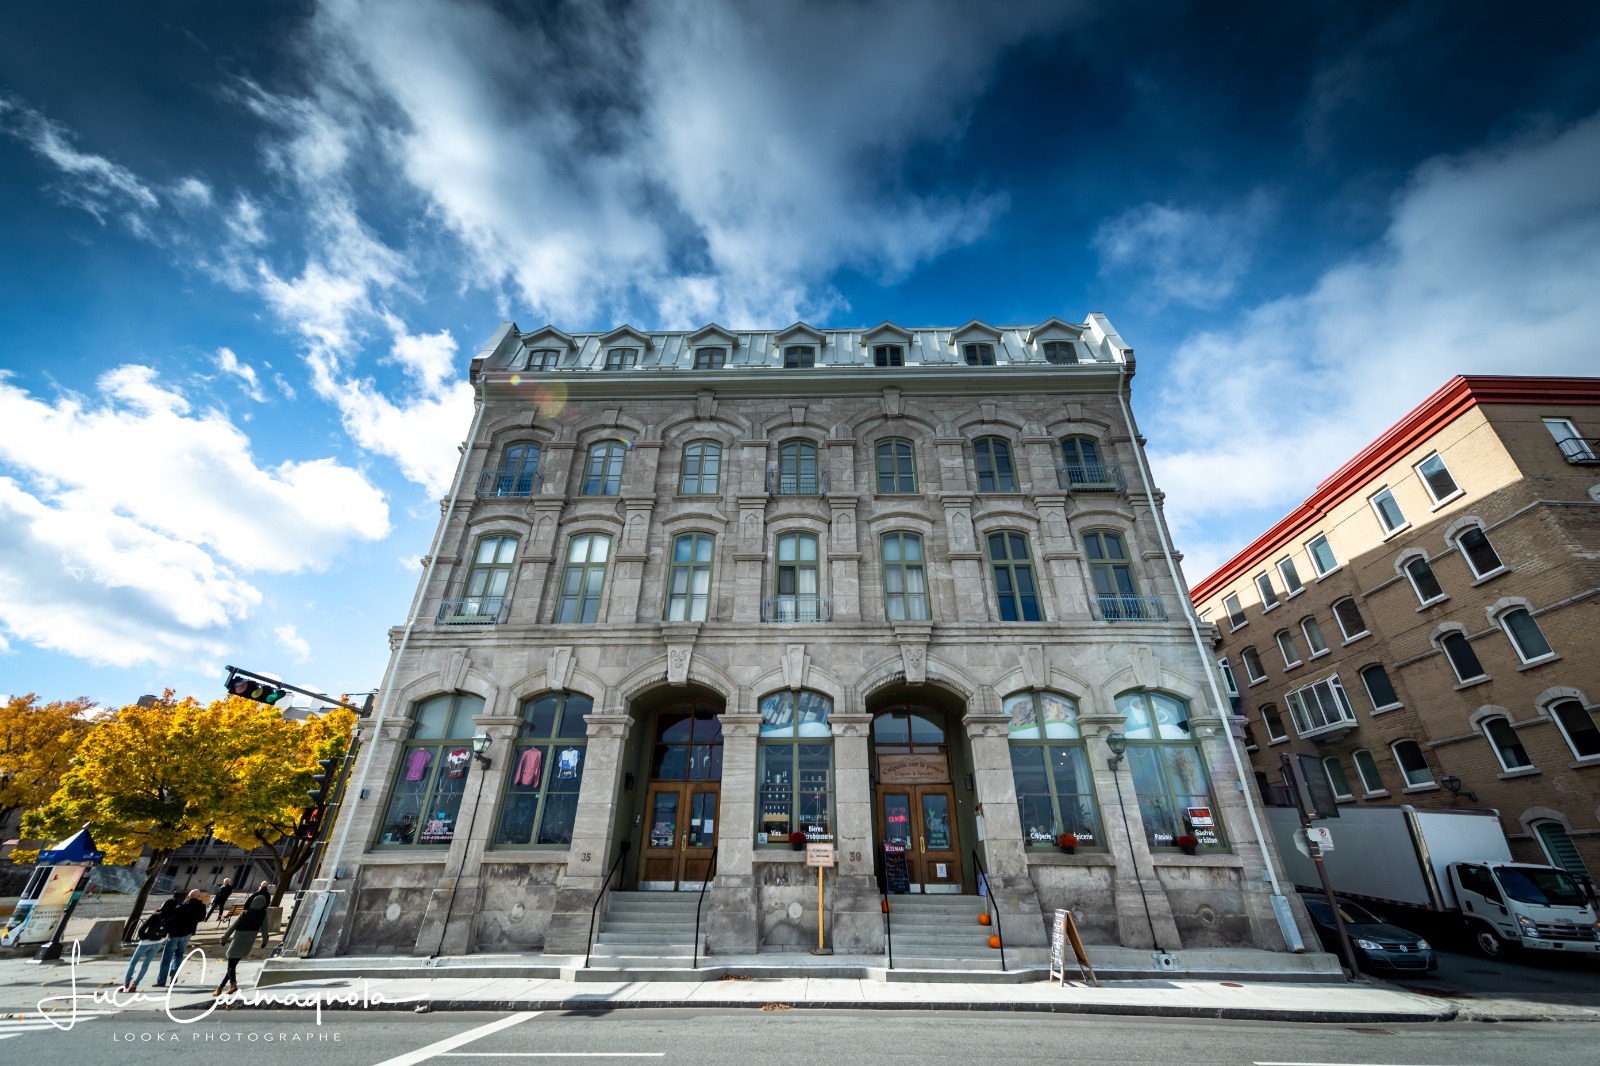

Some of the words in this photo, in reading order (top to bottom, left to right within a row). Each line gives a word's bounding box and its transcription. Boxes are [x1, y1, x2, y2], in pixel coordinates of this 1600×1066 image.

[927, 764, 944, 774] pouce
[770, 829, 781, 837] Vins
[808, 825, 823, 833] Bières
[1030, 831, 1052, 841] Crêperie
[581, 853, 591, 862] 35
[850, 851, 862, 862] 39
